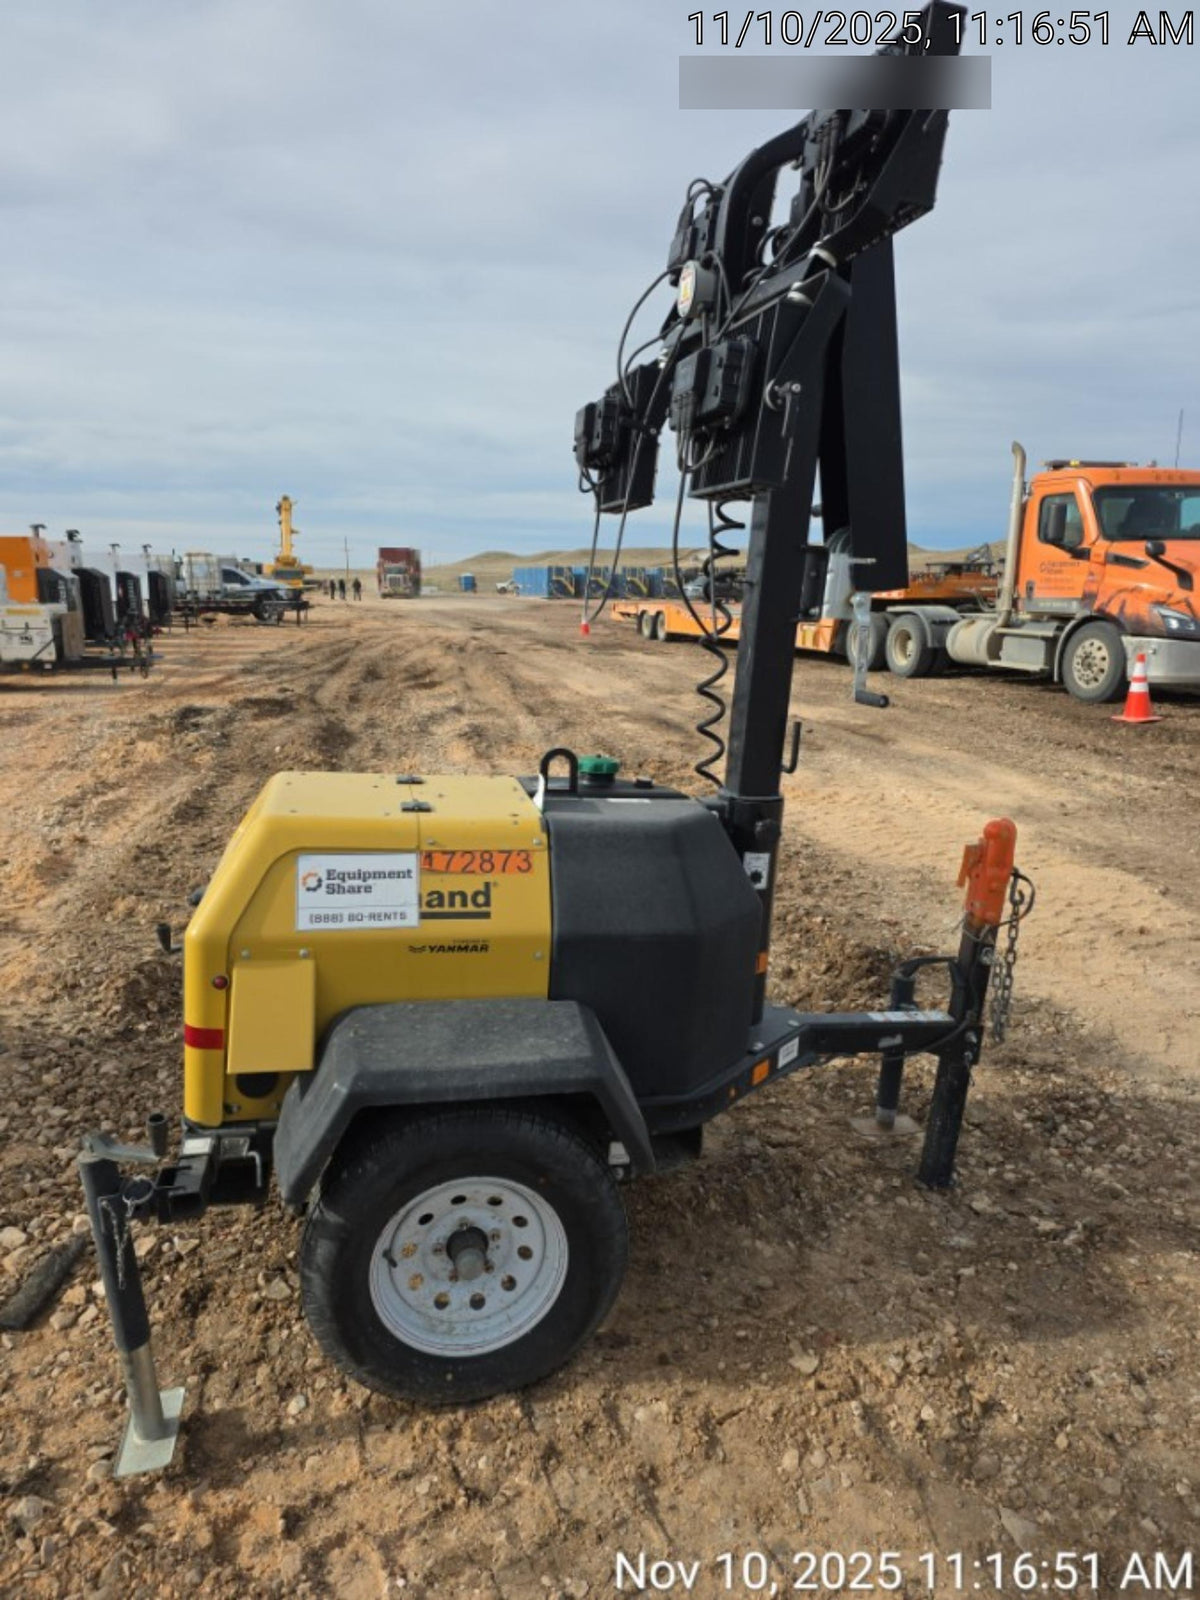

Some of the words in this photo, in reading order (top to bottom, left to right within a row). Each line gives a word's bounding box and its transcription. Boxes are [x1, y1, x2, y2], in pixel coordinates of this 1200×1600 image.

[326, 868, 413, 883] Equipment
[326, 883, 373, 895] Share
[419, 881, 491, 908] and
[428, 943, 490, 954] YANMAR
